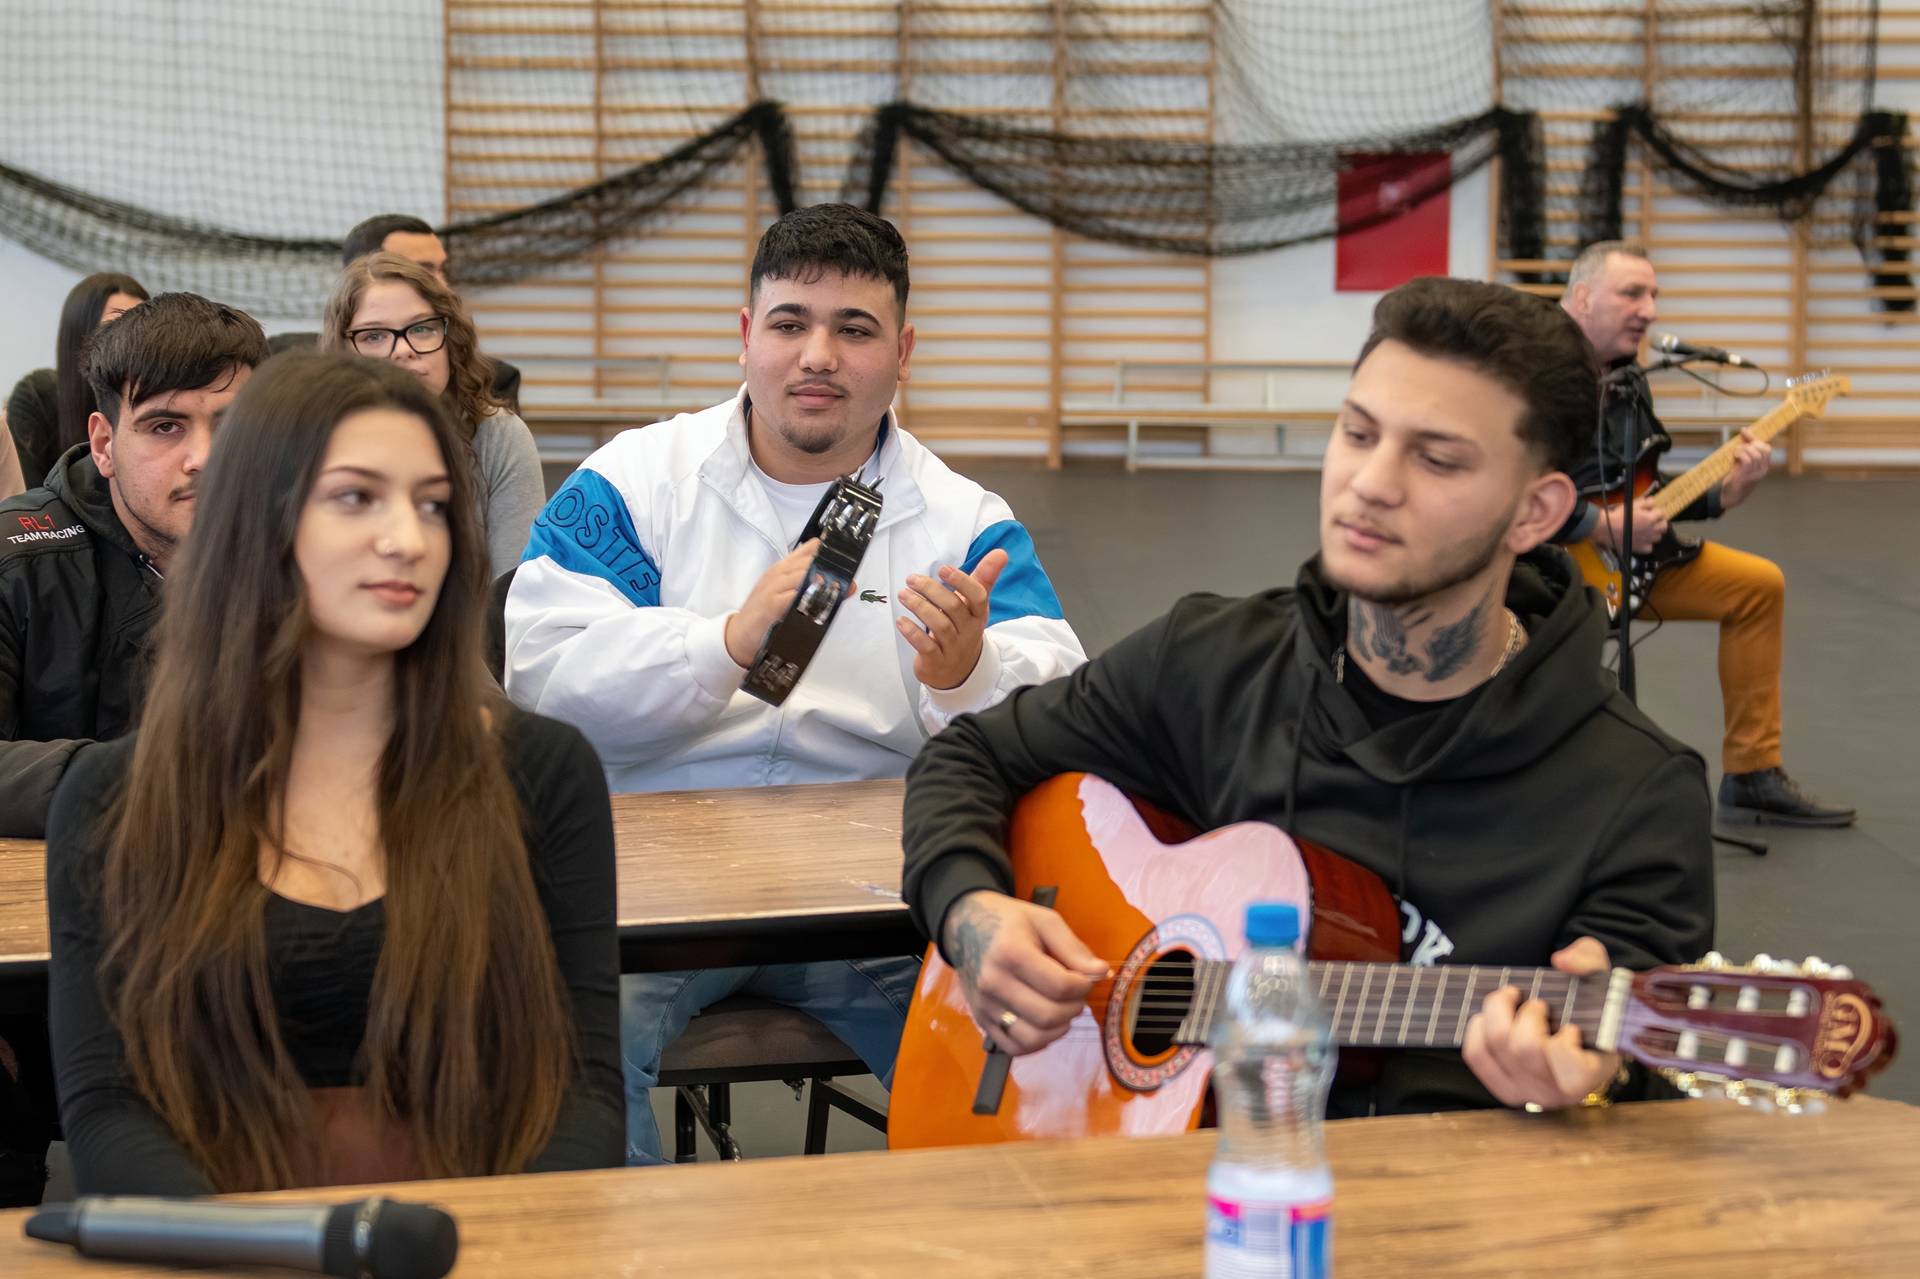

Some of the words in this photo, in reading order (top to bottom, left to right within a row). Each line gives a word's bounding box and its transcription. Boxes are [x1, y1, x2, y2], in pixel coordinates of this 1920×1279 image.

[17, 513, 56, 531] RL1
[7, 531, 42, 544] TEAM
[40, 525, 86, 540] RACING
[535, 488, 661, 592] OSTE
